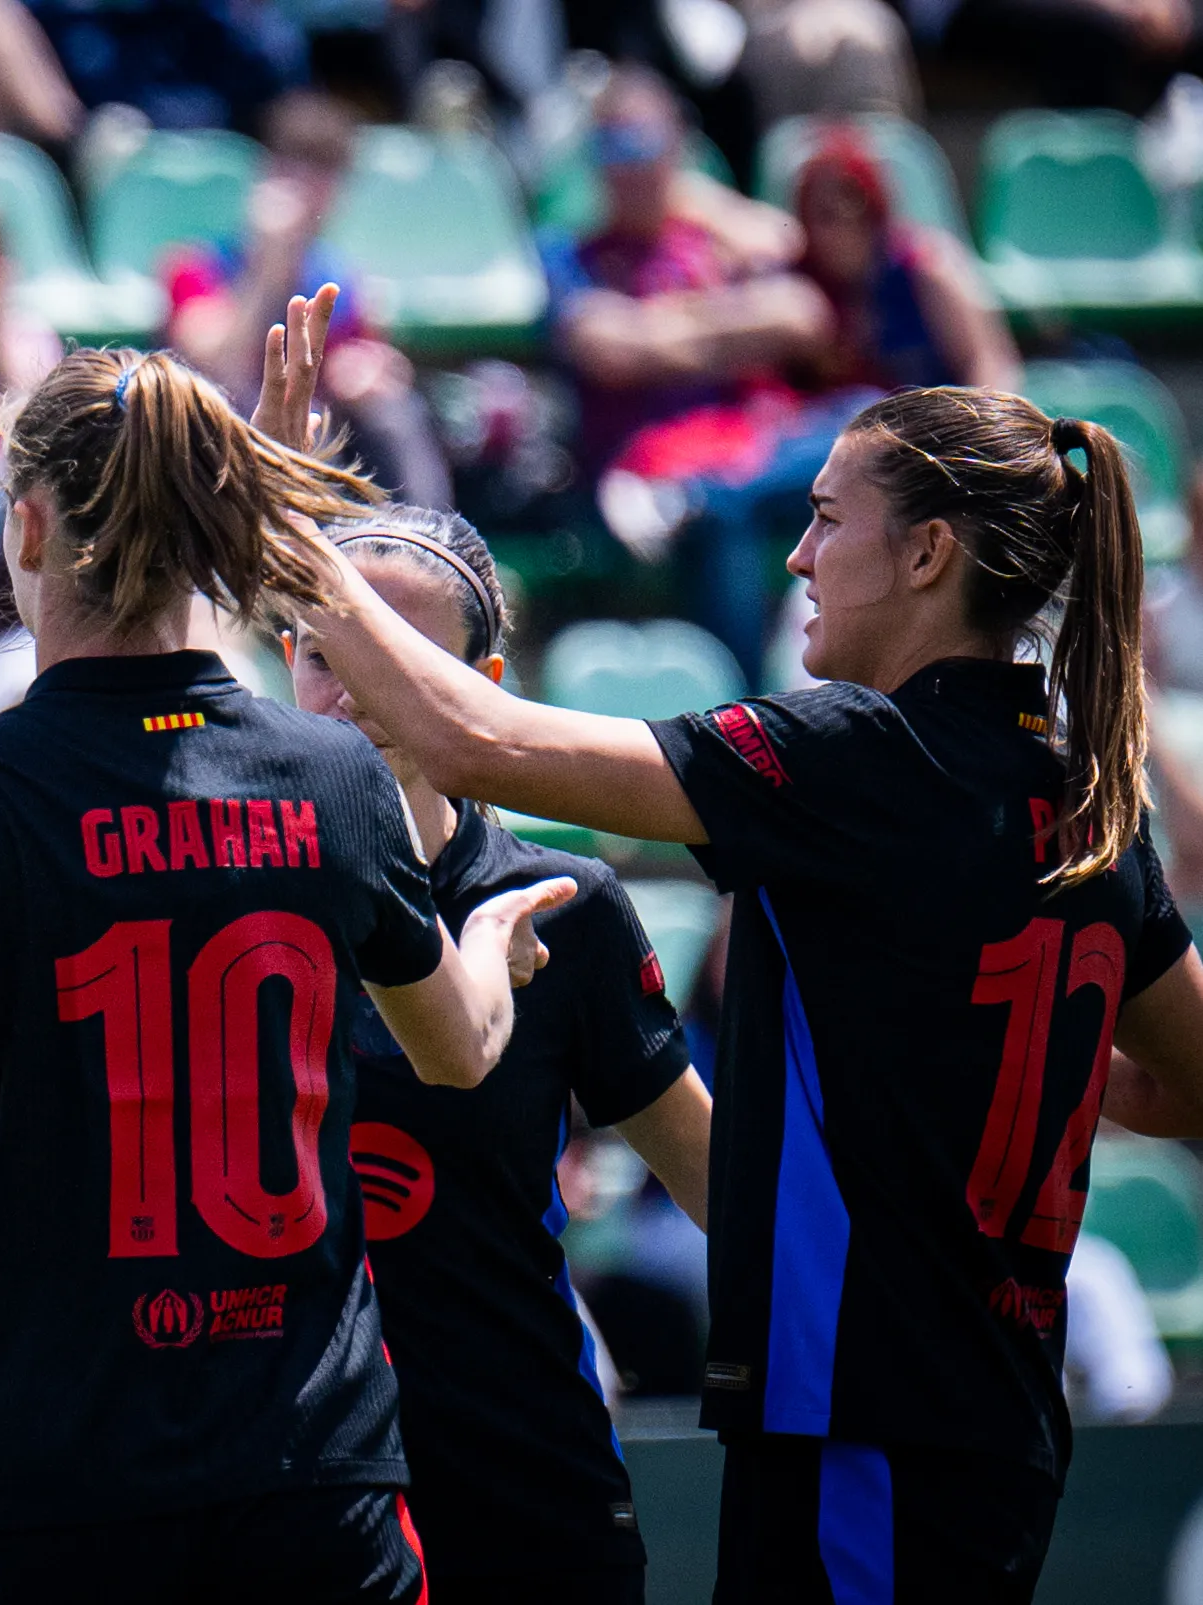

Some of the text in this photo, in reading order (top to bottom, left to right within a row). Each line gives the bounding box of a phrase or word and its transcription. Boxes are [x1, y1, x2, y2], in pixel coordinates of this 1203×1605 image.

[80, 799, 321, 878] GRAHAM
[55, 910, 337, 1259] 10
[966, 917, 1125, 1255] 12
[209, 1306, 284, 1336] ACNUR
[210, 1284, 288, 1313] UNHCR
